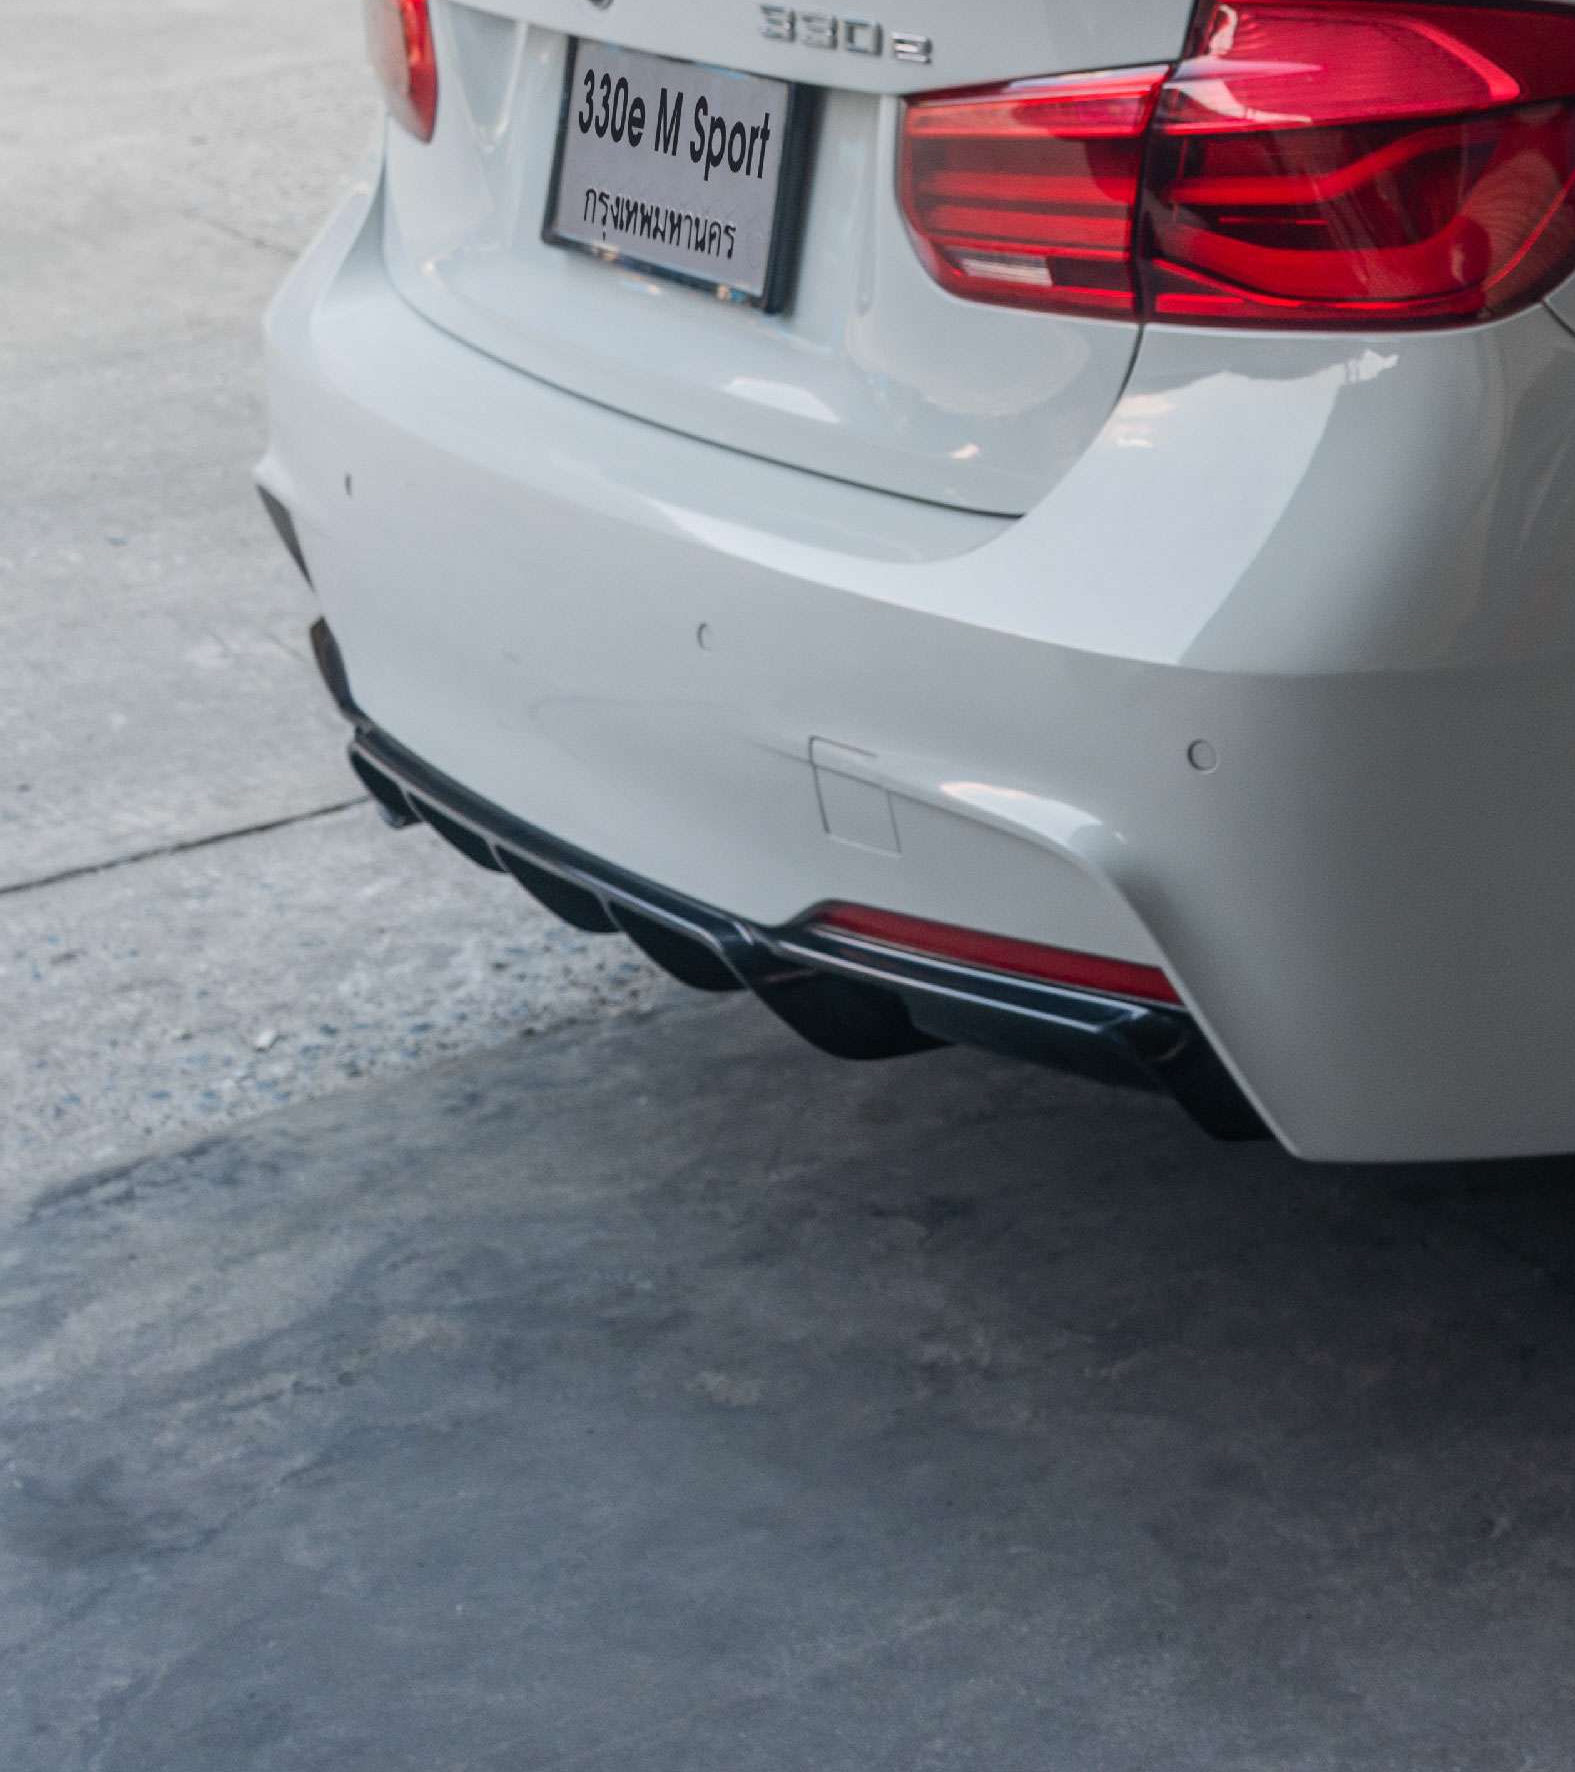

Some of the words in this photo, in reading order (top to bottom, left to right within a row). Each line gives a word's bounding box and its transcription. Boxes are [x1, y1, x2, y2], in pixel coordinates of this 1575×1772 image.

[578, 68, 646, 148] 330e
[654, 87, 684, 157] M
[689, 95, 771, 182] Sport
[583, 187, 737, 260] กรุงเทพมหานคร
